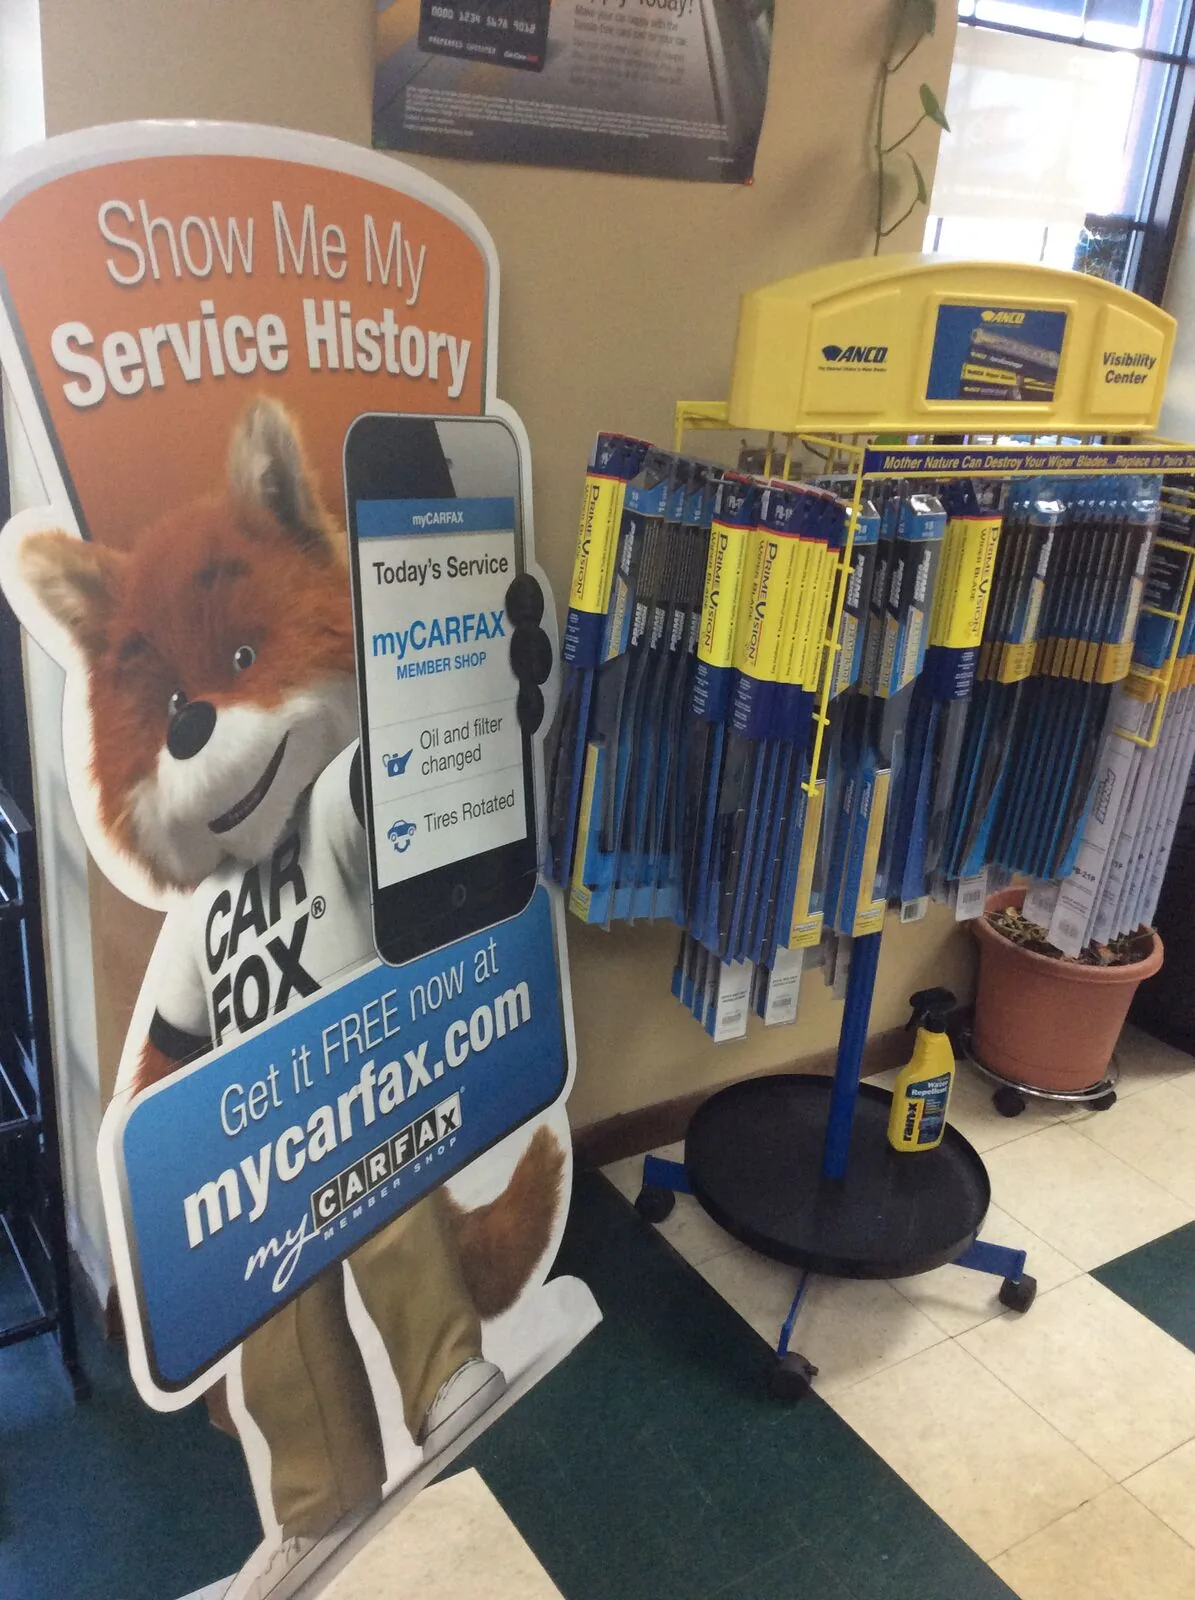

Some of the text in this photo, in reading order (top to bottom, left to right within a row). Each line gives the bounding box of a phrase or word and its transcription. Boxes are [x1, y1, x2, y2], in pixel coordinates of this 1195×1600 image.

[97, 199, 427, 306] Show Me My
[992, 311, 1026, 325] ANCO
[50, 298, 472, 408] Service History
[838, 345, 889, 364] ANCO
[1103, 351, 1157, 370] Visibility
[1105, 369, 1148, 384] Center
[883, 455, 923, 469] Mother
[924, 455, 960, 469] Nature
[961, 455, 982, 469] Can
[984, 455, 1025, 471] Destroy
[1025, 455, 1047, 468] Your
[1048, 455, 1076, 469] Wiper
[412, 511, 464, 528] myCARFAX
[584, 485, 600, 538] PRIME
[372, 553, 509, 586] Today's Service
[576, 540, 591, 595] VISION
[852, 554, 865, 609] PRIME
[969, 528, 988, 602] WIPER BLADE
[971, 526, 1001, 634] PRIME VISION
[704, 534, 729, 647] PRIME VISION
[748, 542, 778, 666] PRIME VISION
[372, 610, 506, 660] myCARFAX
[631, 602, 643, 647] PRIME
[651, 607, 661, 650] PRIME
[670, 609, 680, 653] PRIME
[396, 651, 487, 681] MEMBER SHOP
[420, 717, 503, 750] Oil and filter
[421, 743, 482, 776] changed
[424, 789, 515, 833] Tires Rotated
[205, 840, 308, 976] CAR
[212, 911, 323, 1048] FOX
[220, 937, 500, 1137] Get it FREE now at
[911, 1087, 948, 1097] Repellent
[927, 1080, 949, 1089] Water
[183, 981, 533, 1249] mycarfax.com
[244, 1102, 459, 1294] my CARFAX
[324, 1136, 457, 1241] MEMBER SHOP
